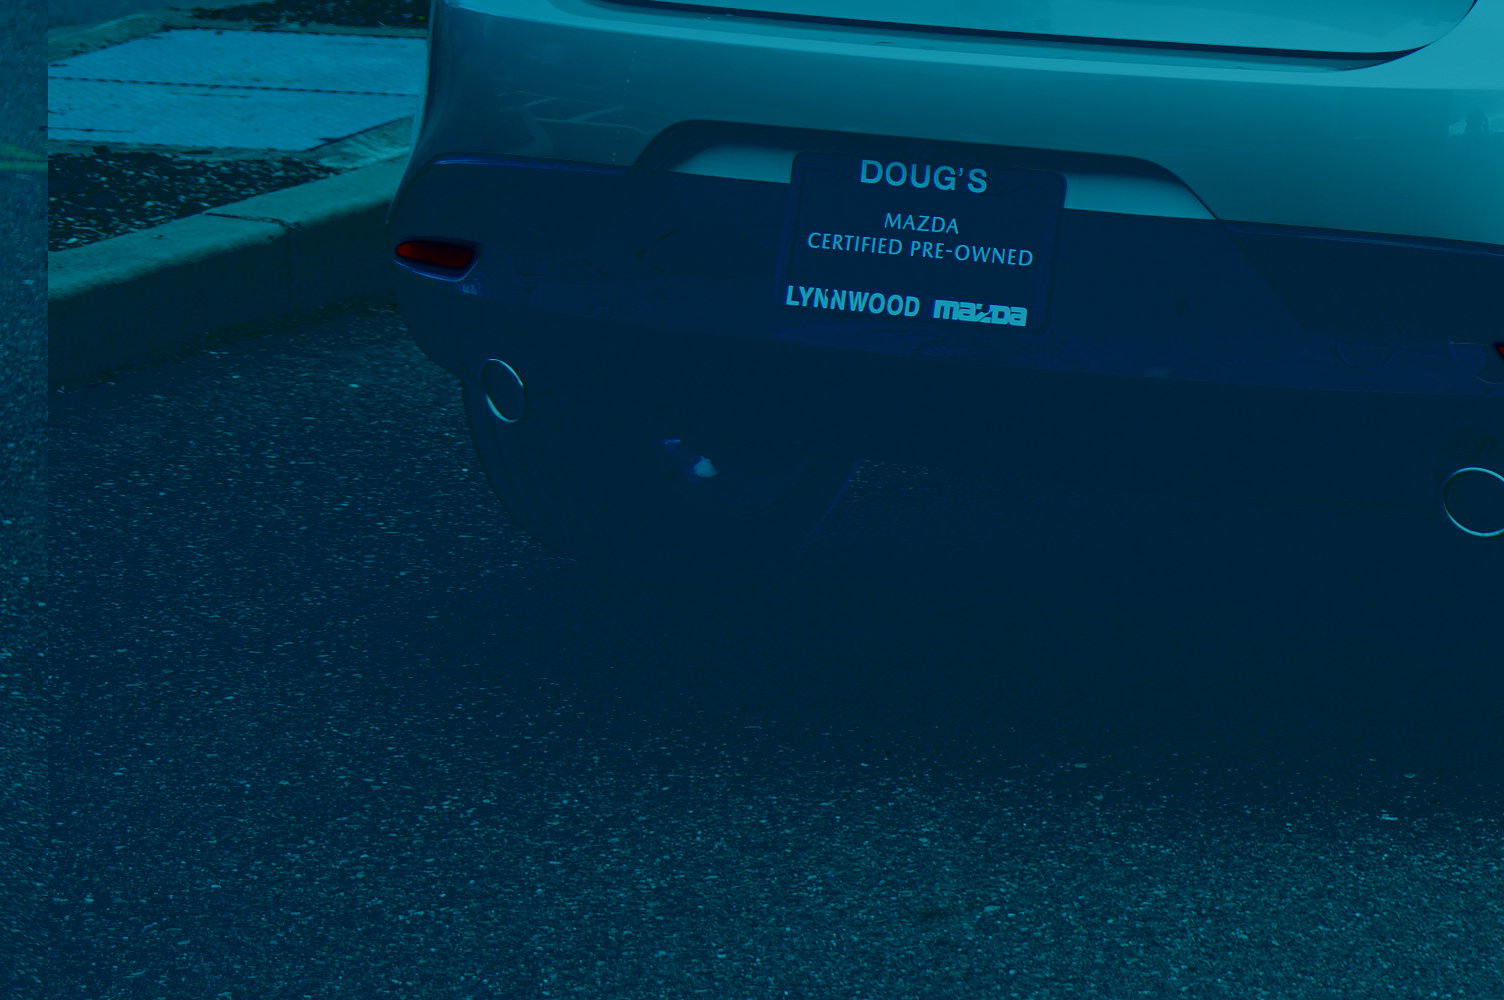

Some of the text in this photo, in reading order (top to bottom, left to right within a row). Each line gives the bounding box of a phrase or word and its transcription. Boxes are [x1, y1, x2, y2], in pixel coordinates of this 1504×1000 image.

[860, 159, 988, 193] DOUG'S
[884, 212, 959, 235] MAZDA
[807, 231, 1034, 267] CERTIFIED PRE-OWNED
[786, 285, 920, 317] LYNNWOOD
